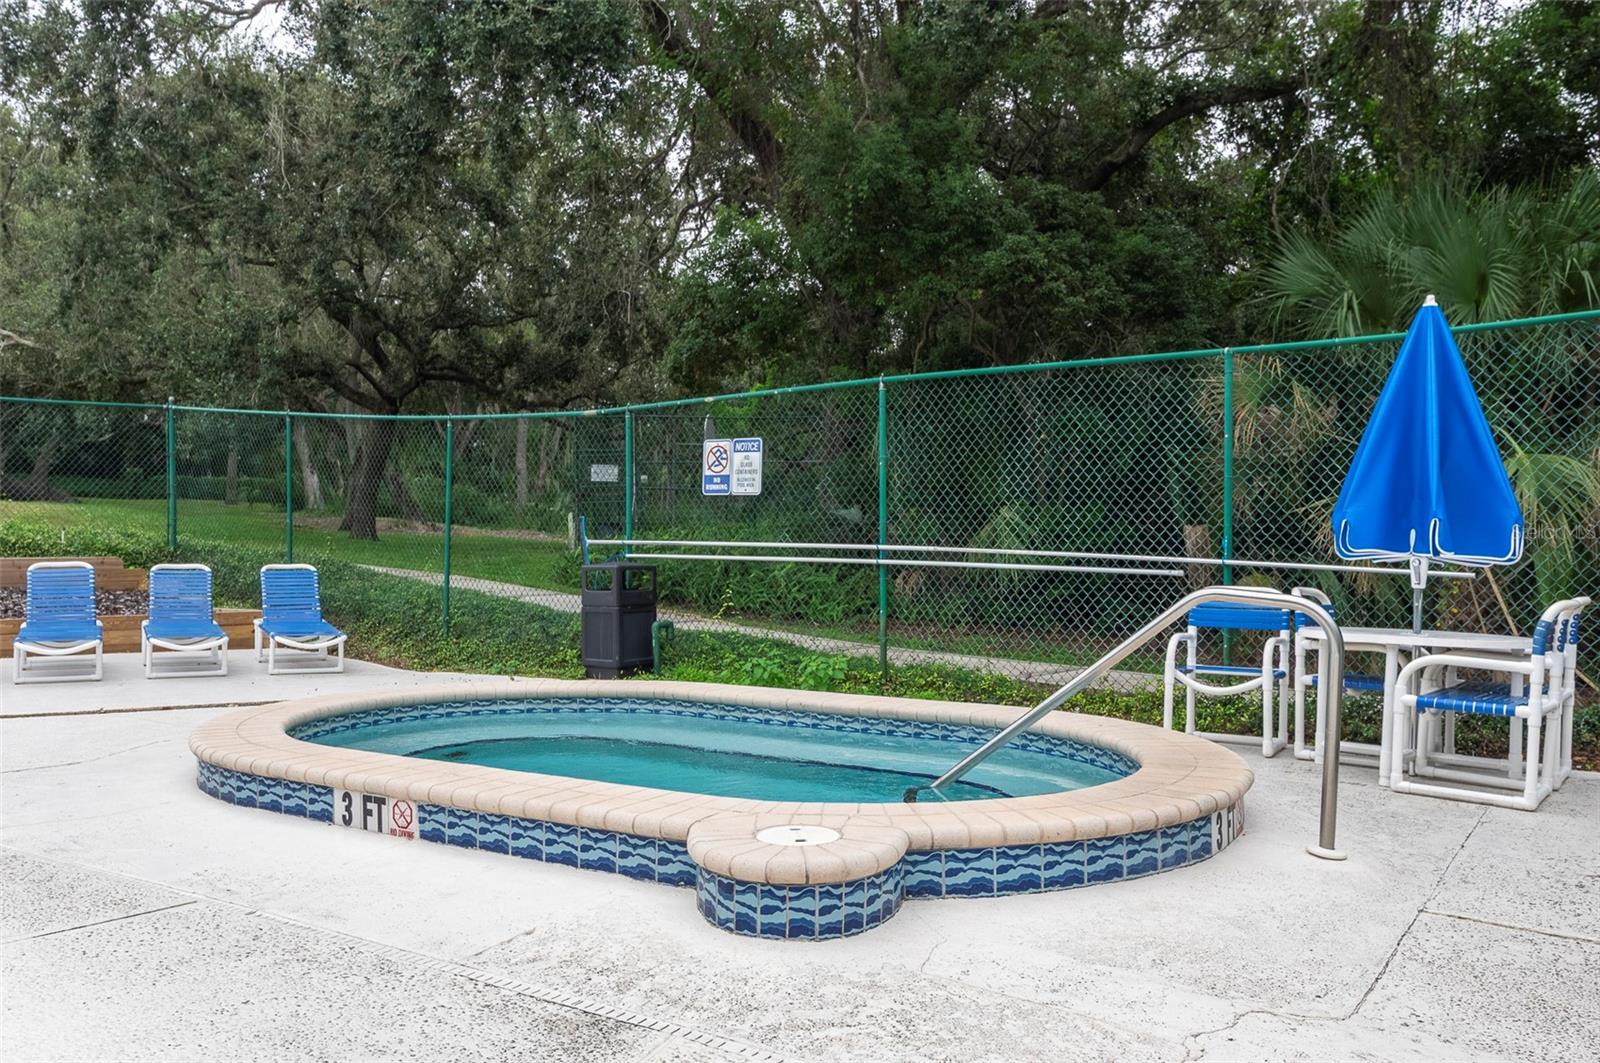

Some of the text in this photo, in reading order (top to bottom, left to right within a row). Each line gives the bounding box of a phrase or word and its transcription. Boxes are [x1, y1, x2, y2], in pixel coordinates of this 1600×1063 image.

[735, 441, 759, 451] NOTICE
[705, 483, 728, 491] RUNNING
[341, 790, 387, 833] 3 FT
[390, 827, 415, 842] NO DIVING
[1216, 811, 1223, 851] 3
